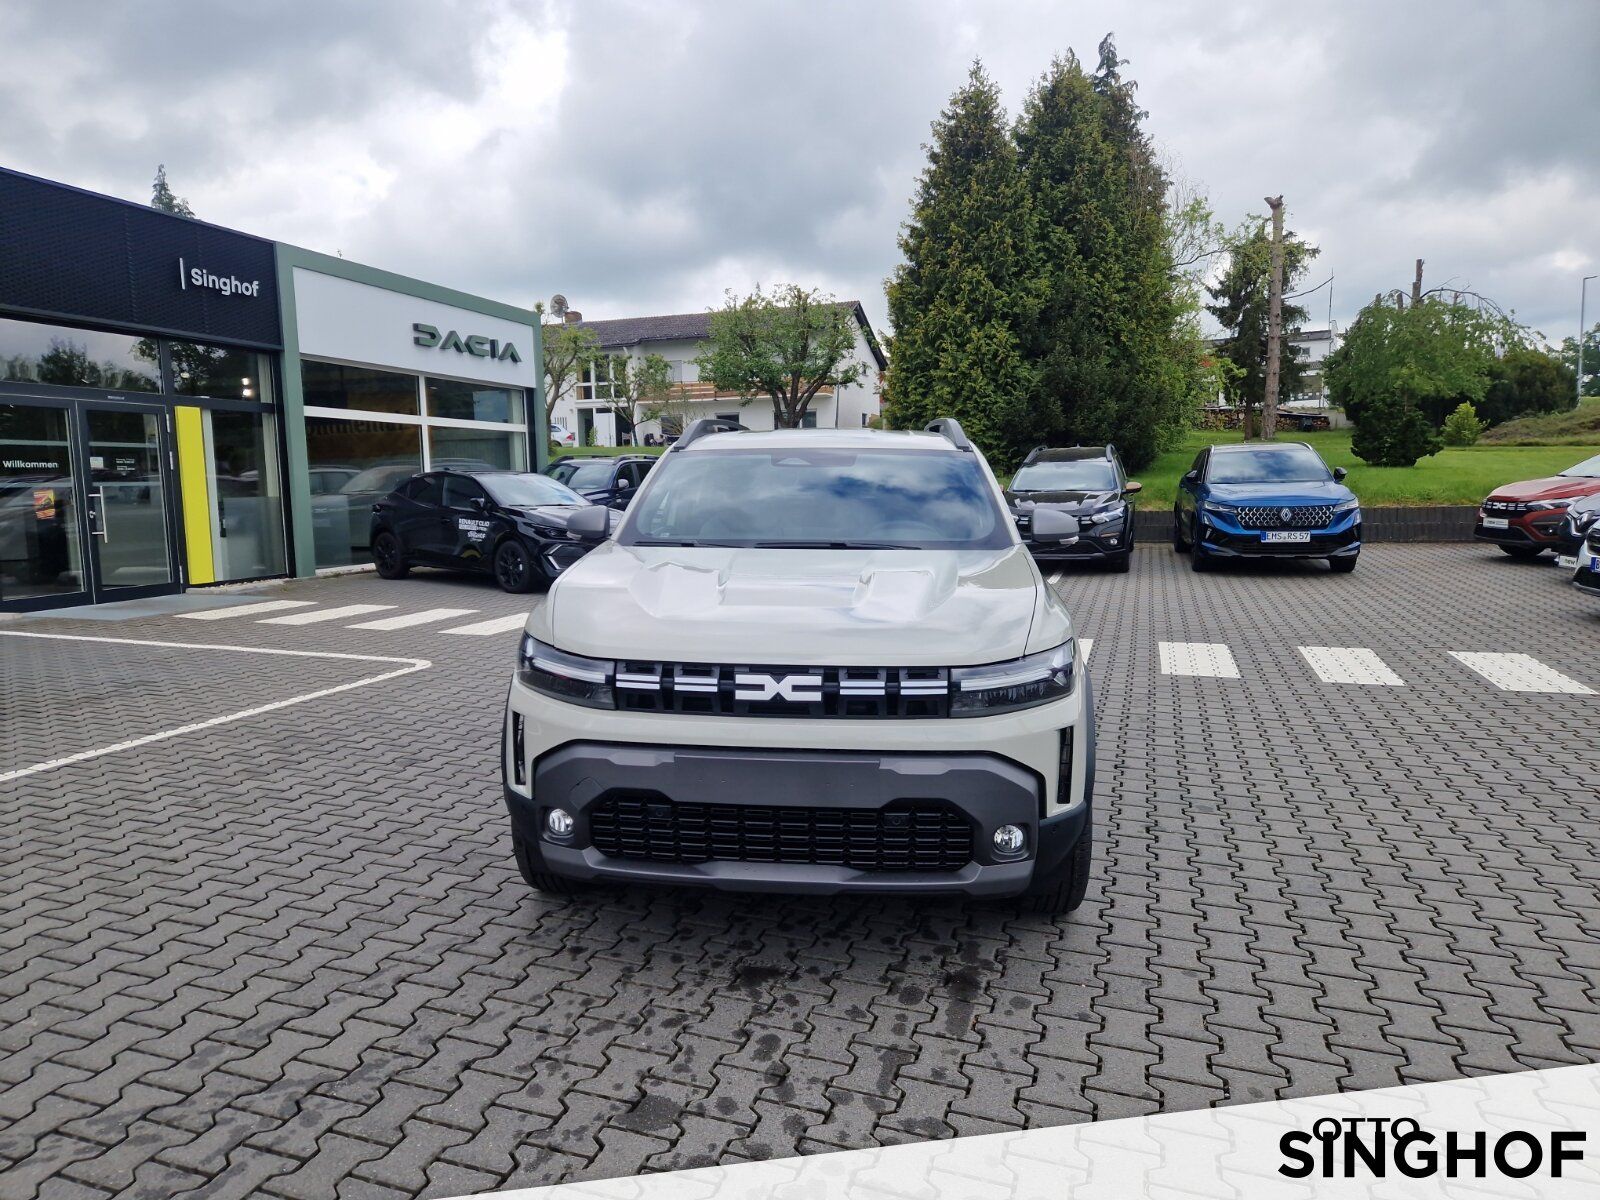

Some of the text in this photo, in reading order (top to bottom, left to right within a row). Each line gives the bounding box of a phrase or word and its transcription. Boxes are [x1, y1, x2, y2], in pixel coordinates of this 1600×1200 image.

[190, 267, 260, 297] Singhof
[412, 322, 522, 363] DACIA
[2, 459, 58, 469] Willkommen
[1266, 532, 1309, 540] EMS RS 57
